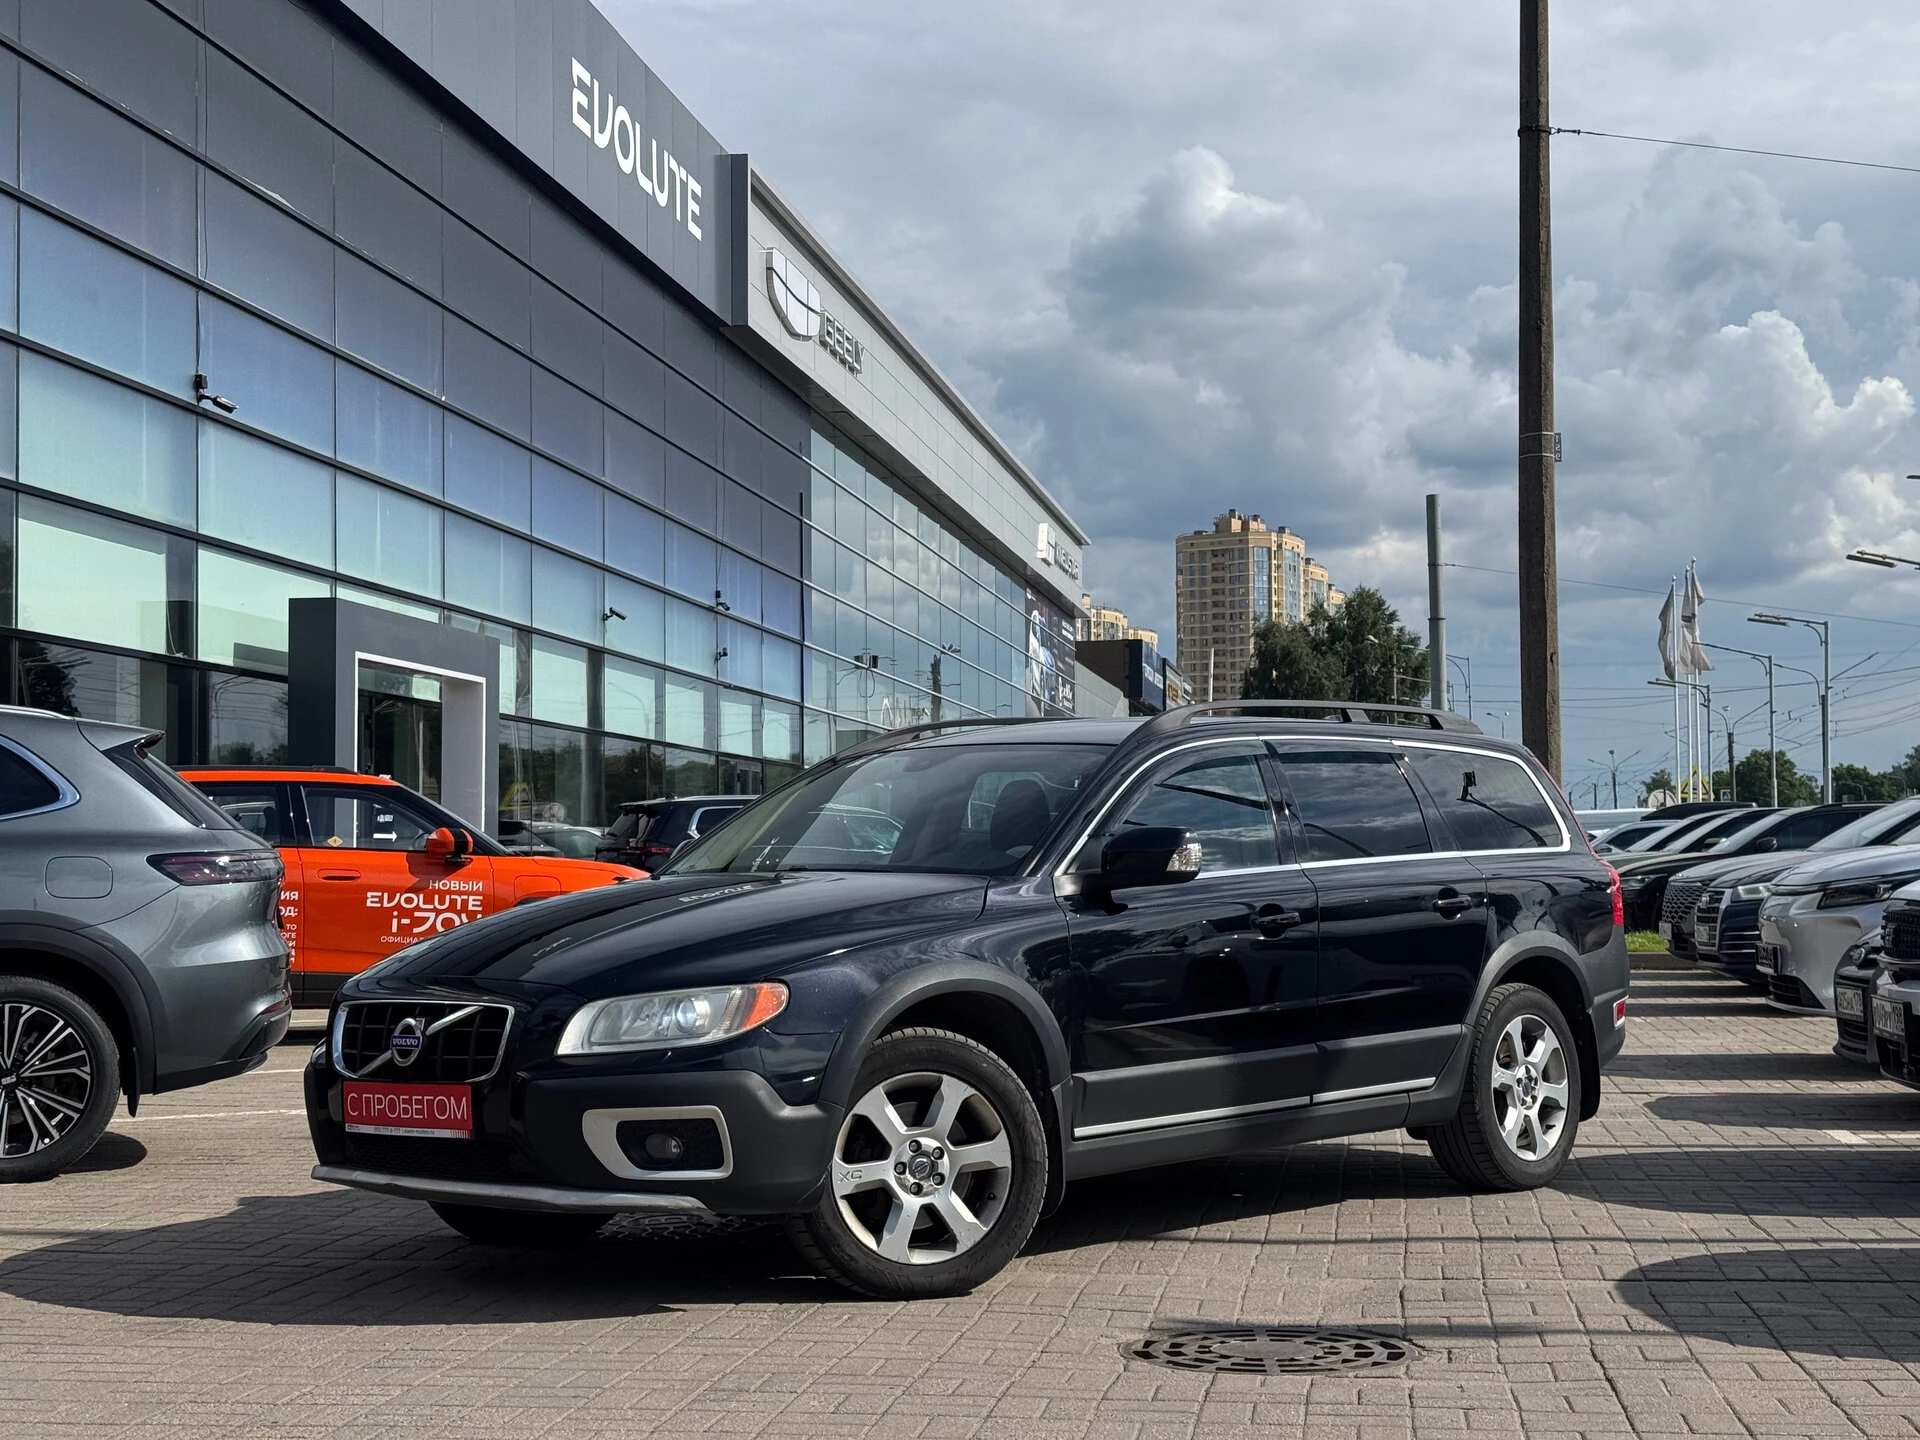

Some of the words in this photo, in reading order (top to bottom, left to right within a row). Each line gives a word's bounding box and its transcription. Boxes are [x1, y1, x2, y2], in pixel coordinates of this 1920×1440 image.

[571, 56, 702, 242] EVOLUTE
[819, 309, 866, 374] GEELY
[280, 890, 299, 901] ИЯ
[366, 891, 483, 911] EVOLUTE
[278, 906, 298, 917] ОД:
[279, 932, 297, 940] ОГЕ
[380, 935, 424, 945] ОФИЦИА
[392, 1038, 418, 1046] VOLVO
[347, 1092, 359, 1116] С
[362, 1093, 467, 1121] ПРОБЕГОМ
